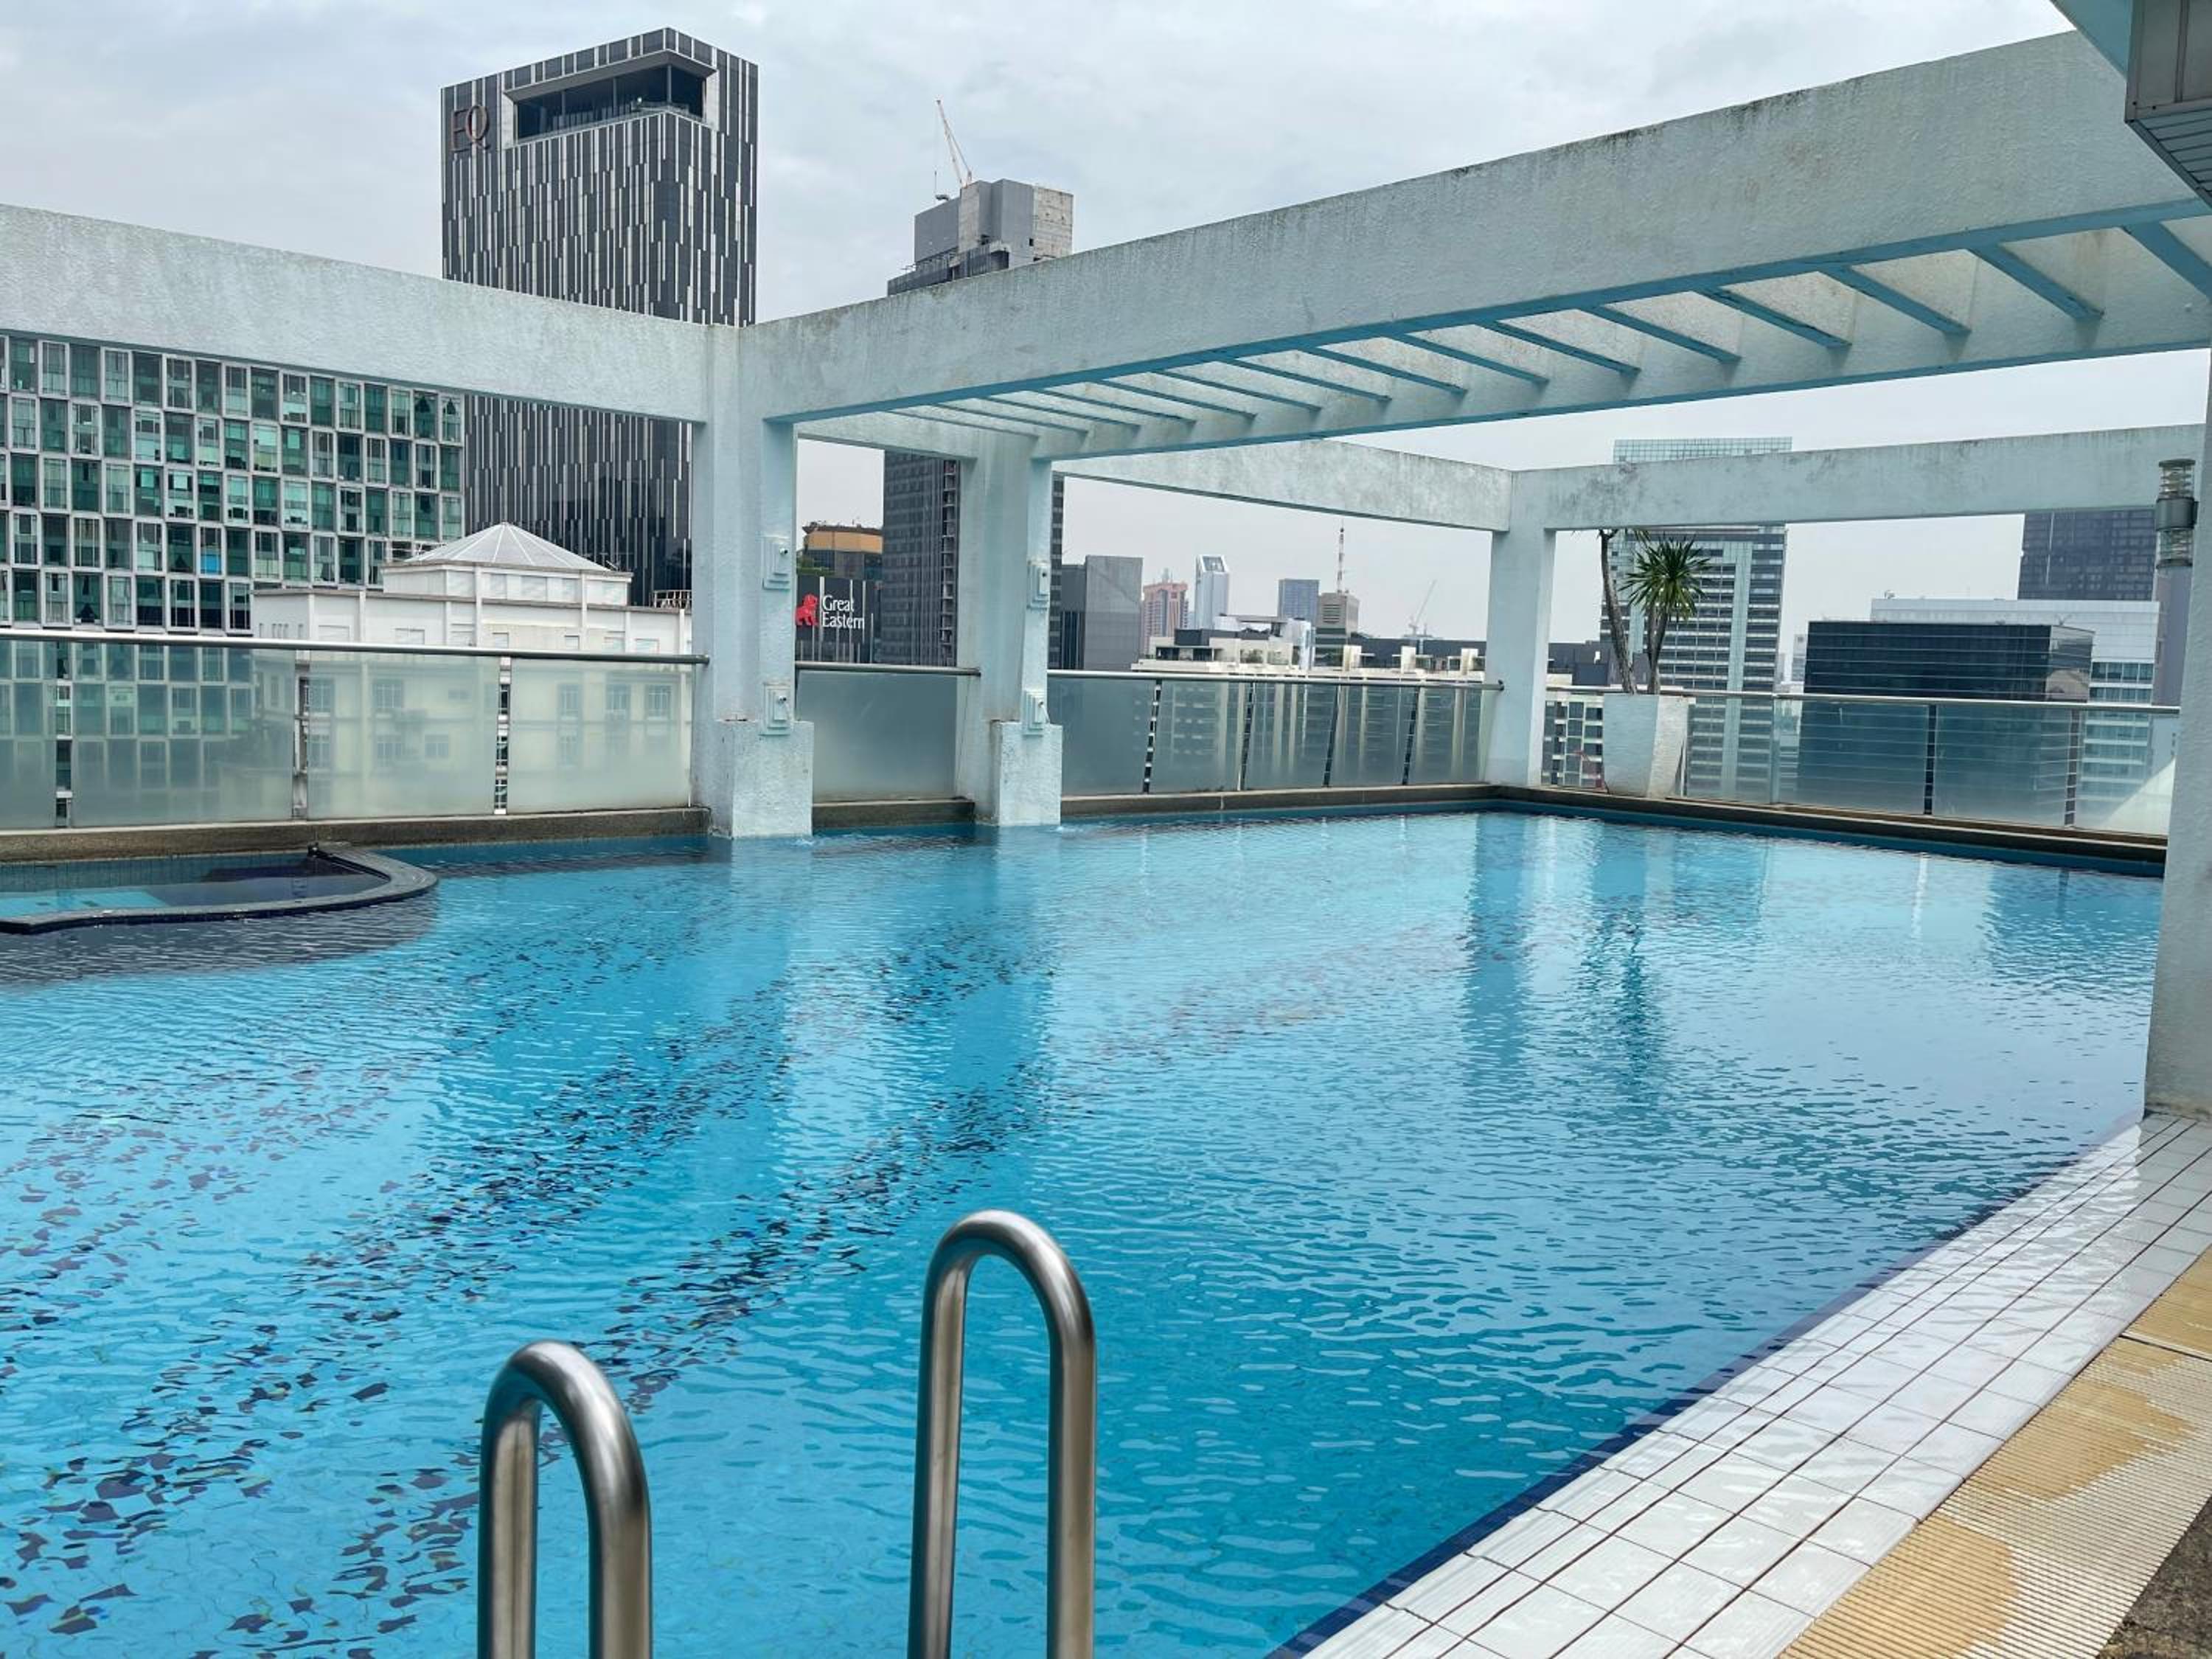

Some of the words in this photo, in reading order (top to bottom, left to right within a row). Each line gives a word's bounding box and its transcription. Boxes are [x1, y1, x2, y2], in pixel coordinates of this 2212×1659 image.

[450, 105, 491, 153] EQ
[822, 594, 855, 612] Great
[822, 611, 865, 630] Eastern
